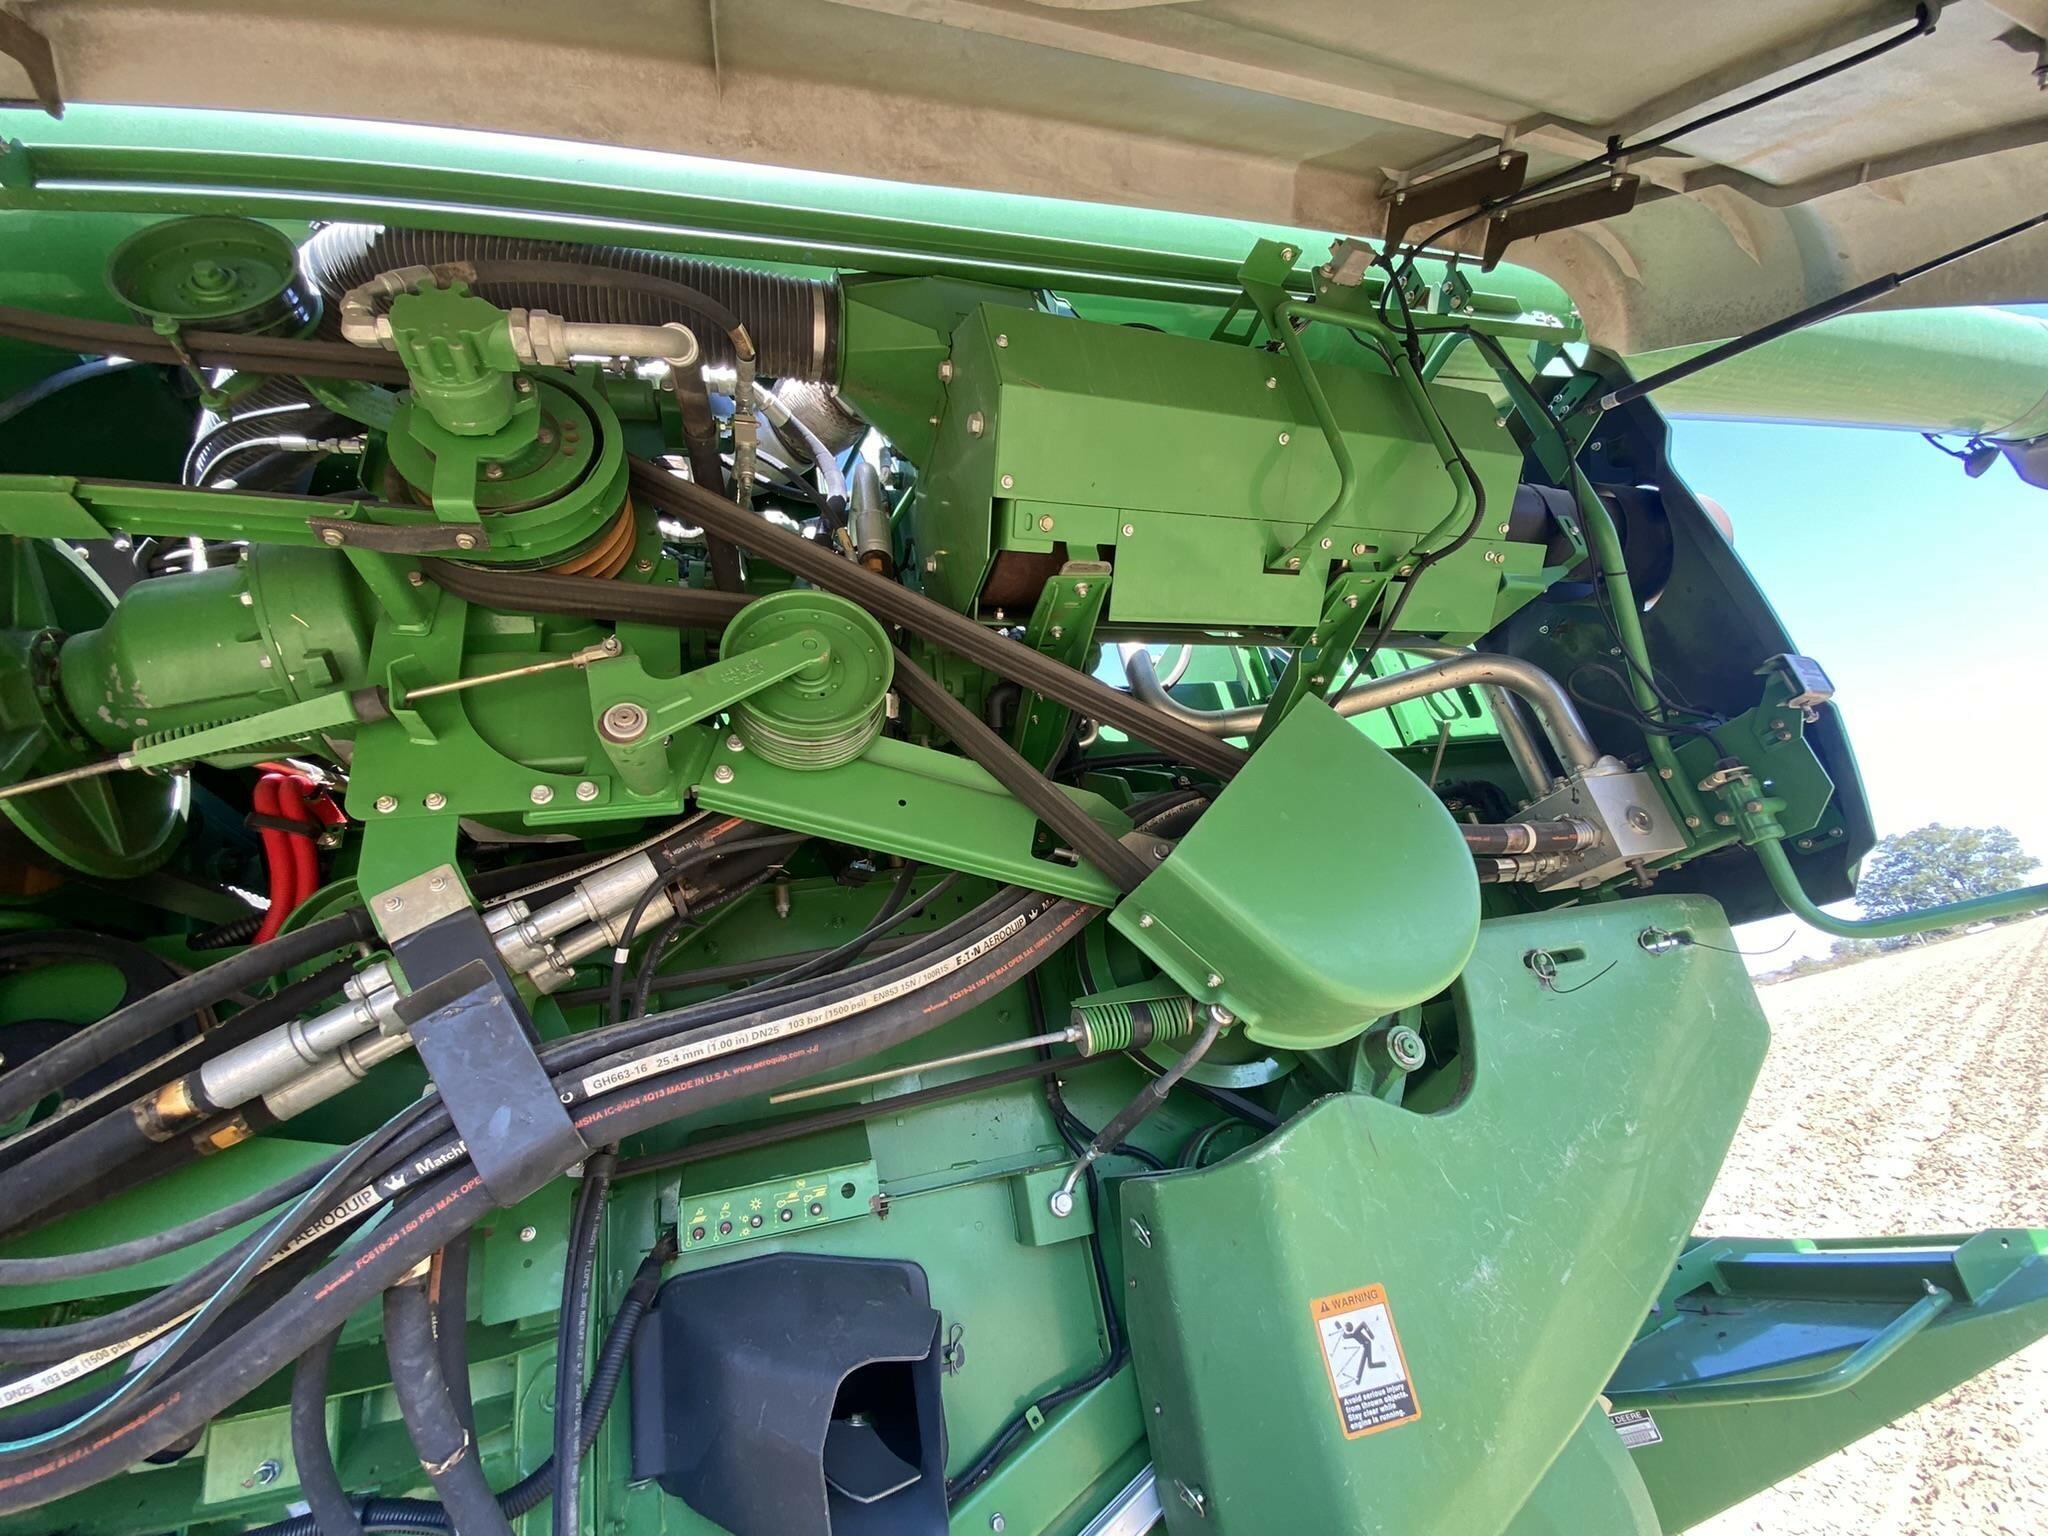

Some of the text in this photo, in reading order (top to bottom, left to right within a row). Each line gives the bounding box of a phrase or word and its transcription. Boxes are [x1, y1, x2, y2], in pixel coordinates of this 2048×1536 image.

[593, 1063, 648, 1090] GH663-16
[656, 1054, 679, 1068] 25.4
[683, 1048, 704, 1061] mm
[706, 1038, 732, 1054] (1.00
[735, 1034, 749, 1045] in)
[752, 1026, 780, 1041] DN25
[788, 1019, 804, 1030] 103
[807, 1013, 822, 1025] bar
[825, 1005, 849, 1020] (1500
[851, 998, 867, 1012] psi)
[983, 917, 1025, 949] AEROQUIP
[666, 1079, 694, 1096] MADE
[694, 1076, 705, 1087] IN
[706, 1069, 732, 1083] U.S.A.
[419, 1208, 436, 1225] PSI
[436, 1190, 460, 1212] MAX
[1331, 1289, 1378, 1309] WARNING
[41, 1374, 61, 1387] 103
[61, 1364, 81, 1378] bar
[1344, 1394, 1363, 1406] Avoid
[1363, 1389, 1386, 1400] serious
[1345, 1391, 1408, 1413] from thrown objects.
[1348, 1403, 1396, 1422] Stay clear while
[1350, 1418, 1372, 1430] engine
[1372, 1416, 1379, 1424] is
[1615, 1411, 1642, 1423] DEERE
